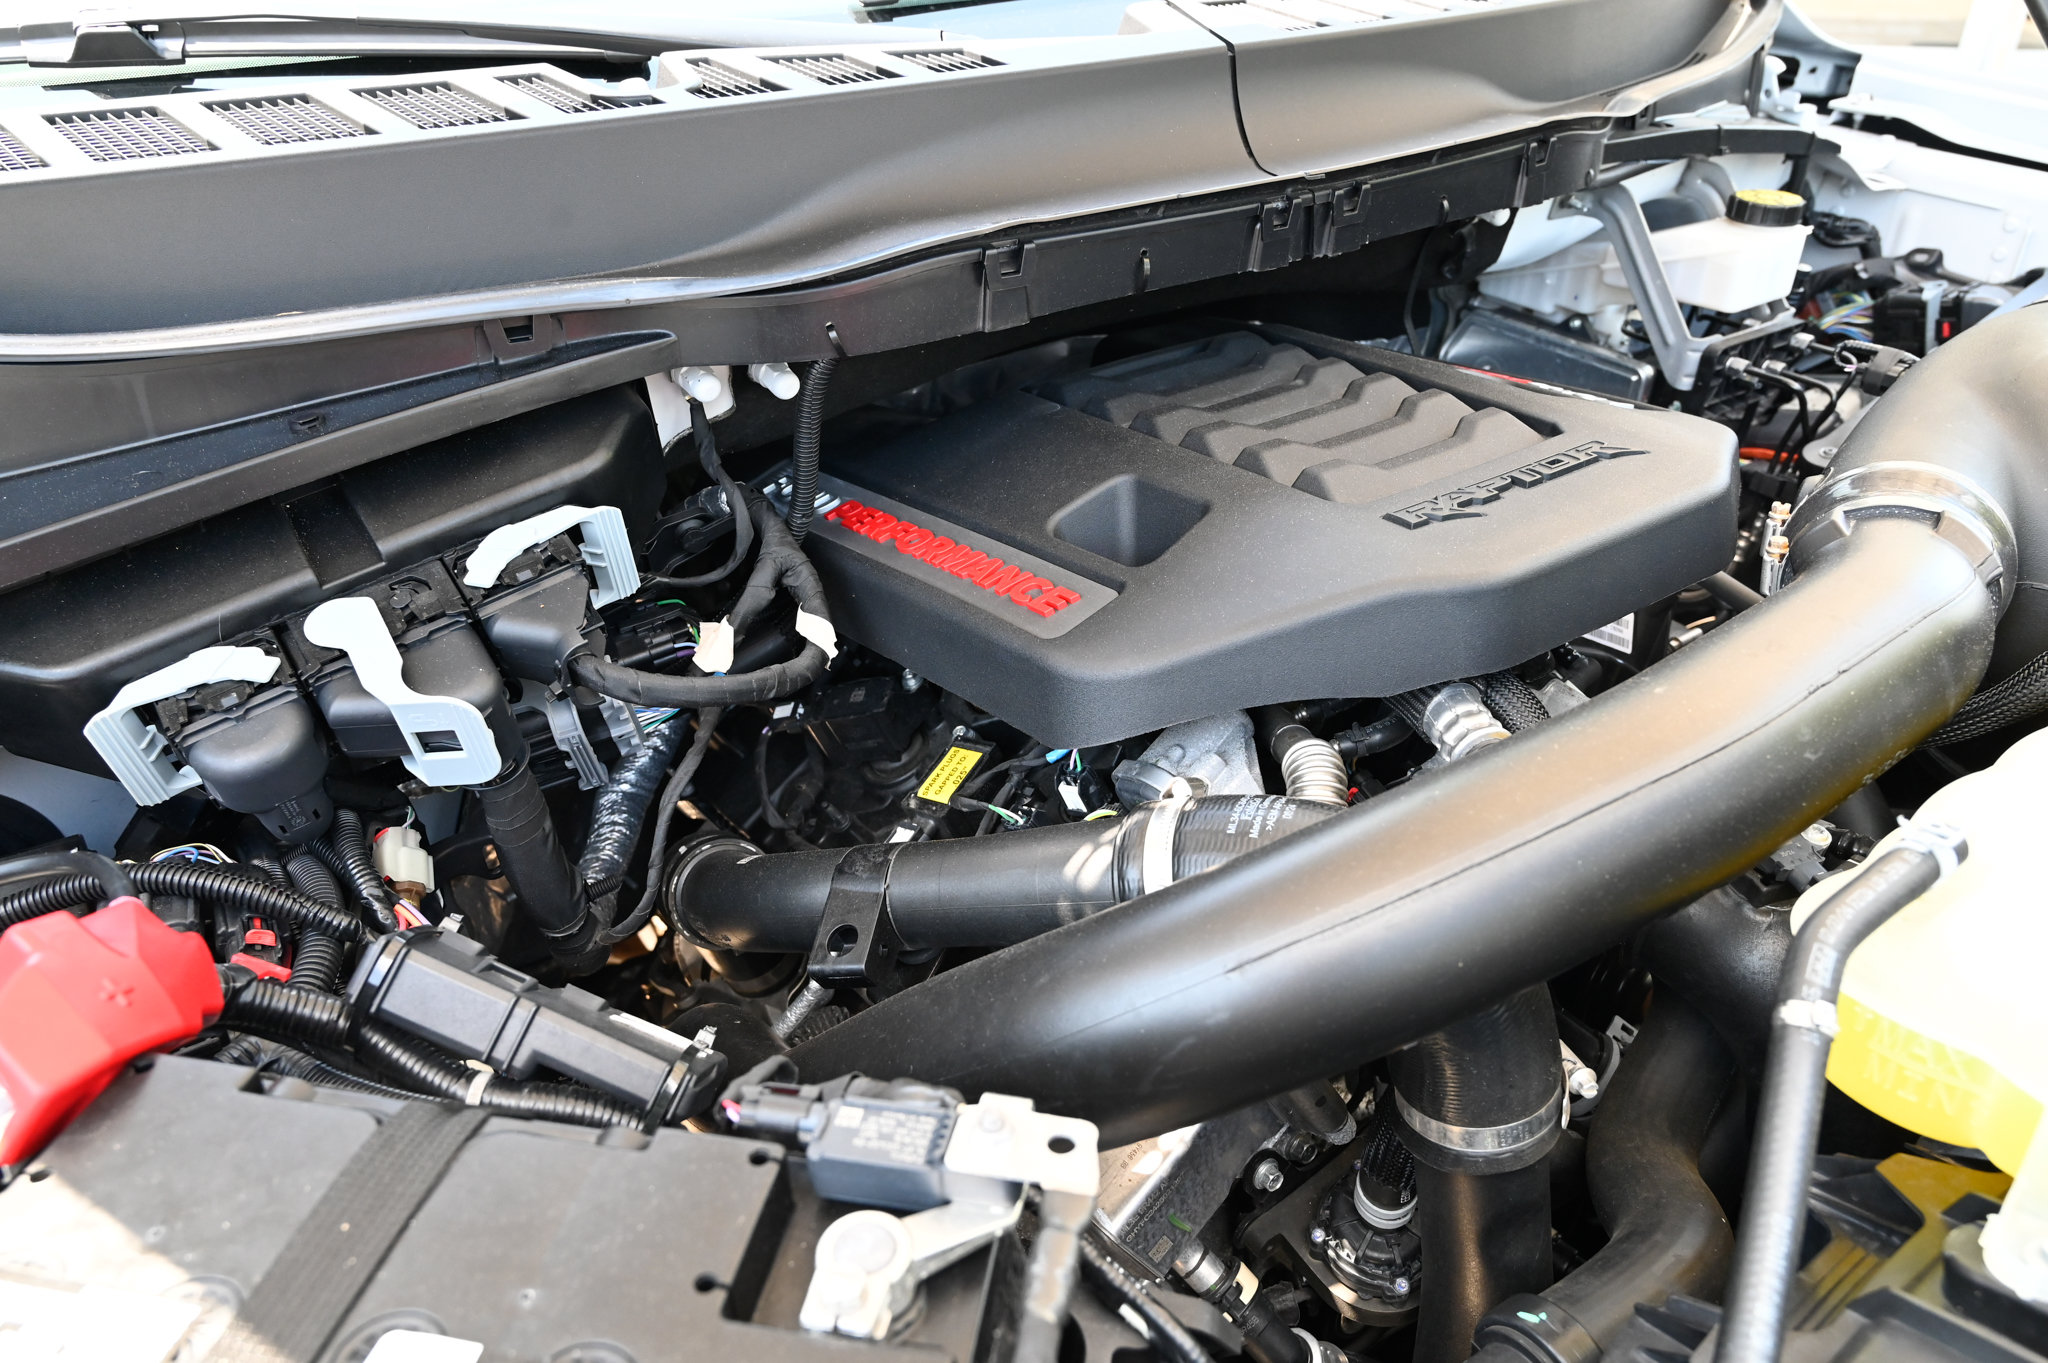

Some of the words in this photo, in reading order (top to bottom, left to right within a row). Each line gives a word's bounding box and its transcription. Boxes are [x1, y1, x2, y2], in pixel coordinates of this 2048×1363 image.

[1380, 440, 1651, 530] RAPTOR
[824, 500, 1081, 618] PERFORMANCE
[922, 772, 942, 796] SPARK
[940, 749, 960, 772] PLUGS
[934, 767, 958, 795] GAPPED
[1862, 1053, 1961, 1116] MIN
